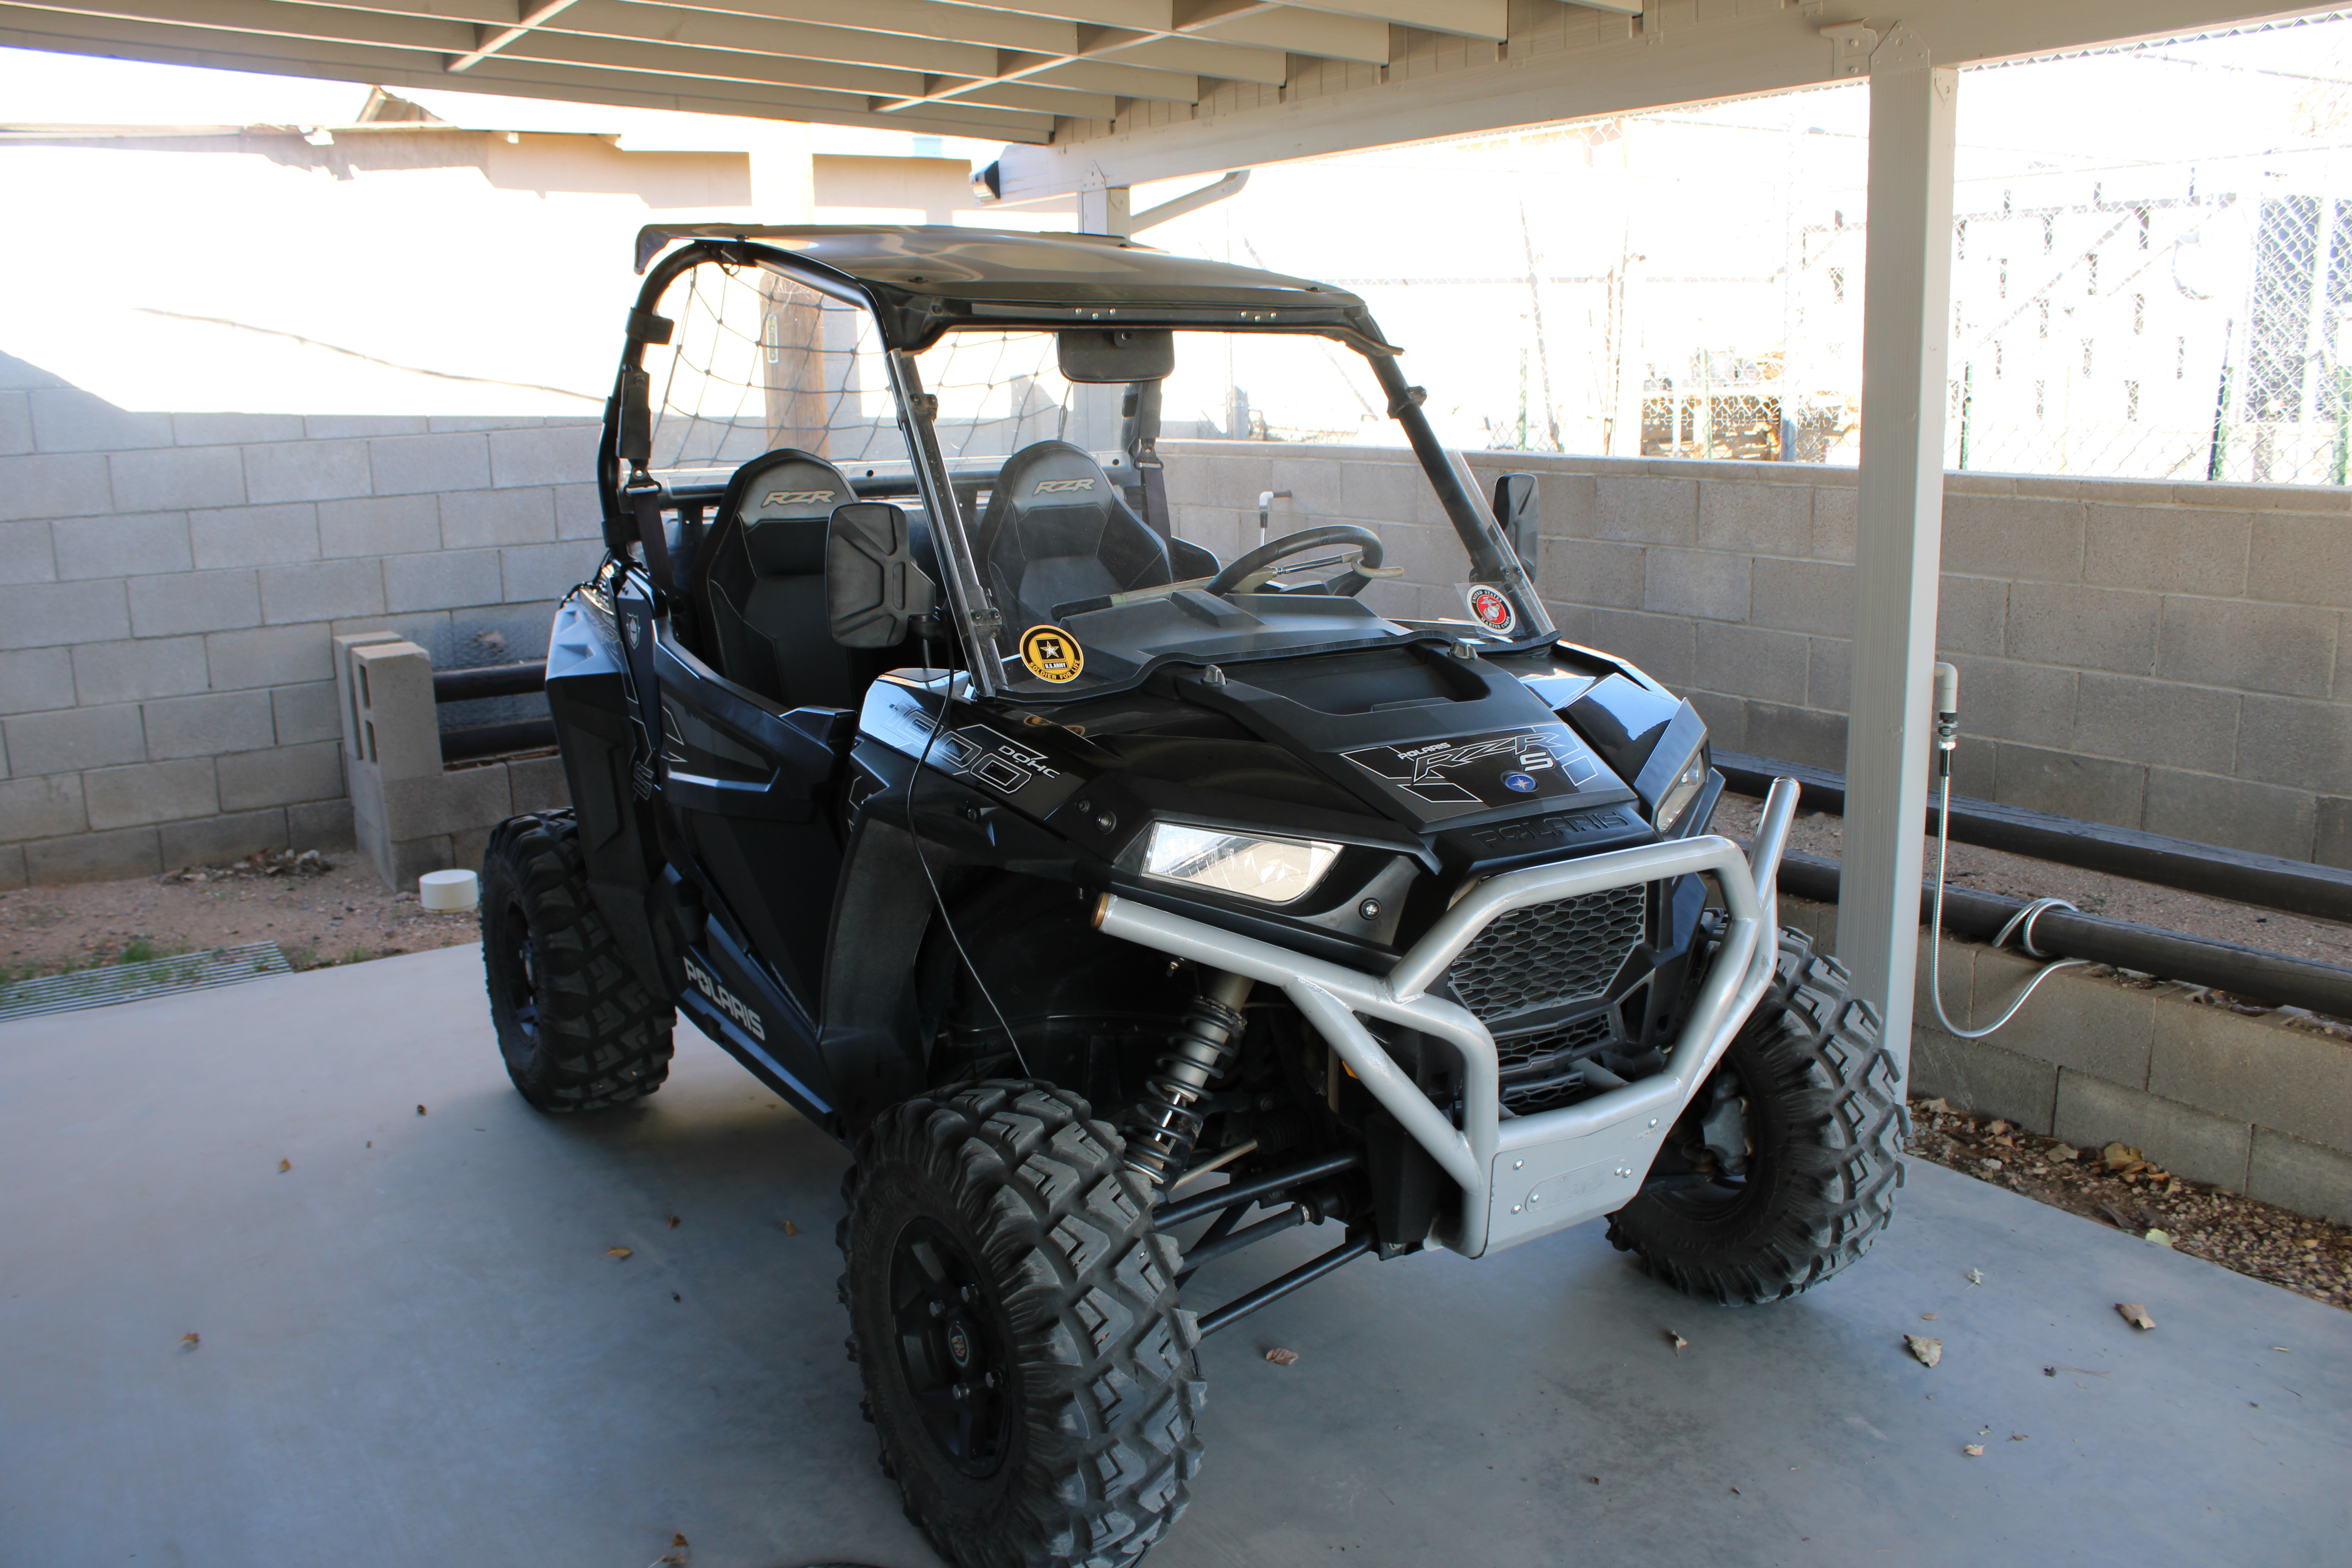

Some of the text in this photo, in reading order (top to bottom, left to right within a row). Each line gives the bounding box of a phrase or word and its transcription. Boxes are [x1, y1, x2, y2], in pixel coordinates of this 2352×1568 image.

[1033, 478, 1096, 496] RZR
[760, 490, 836, 508] RZR
[1472, 590, 1502, 603] UNITED STATES
[1481, 616, 1511, 629] MARINE CORPS
[1029, 662, 1057, 679] SOLDIER
[1072, 659, 1080, 672] LIFE
[1397, 742, 1451, 760] POLARIS
[1414, 732, 1563, 782] RZR
[1519, 751, 1554, 771] S
[998, 745, 1060, 778] DOHC
[1472, 811, 1628, 849] POLARIS
[683, 956, 765, 1041] POLARIS
